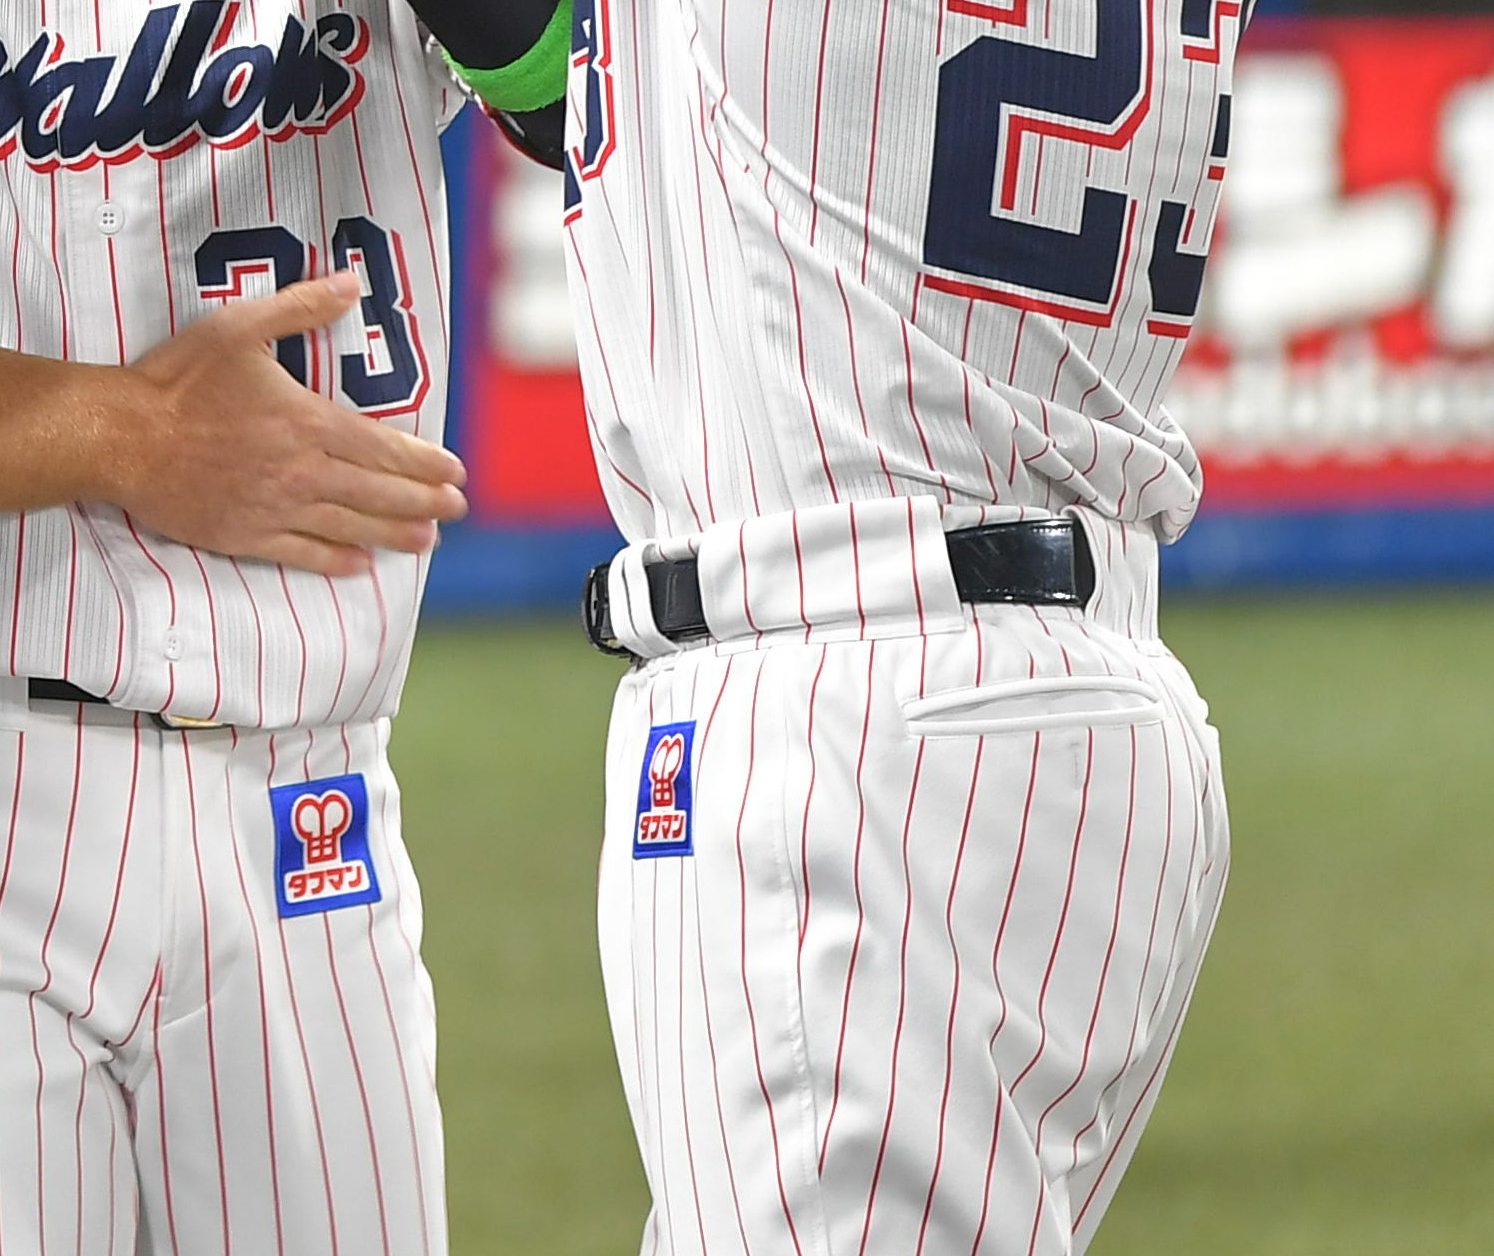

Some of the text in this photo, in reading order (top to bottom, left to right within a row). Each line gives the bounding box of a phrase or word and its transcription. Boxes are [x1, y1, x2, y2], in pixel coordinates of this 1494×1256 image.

[639, 813, 686, 842] タフマン
[287, 864, 363, 900] タフマン
